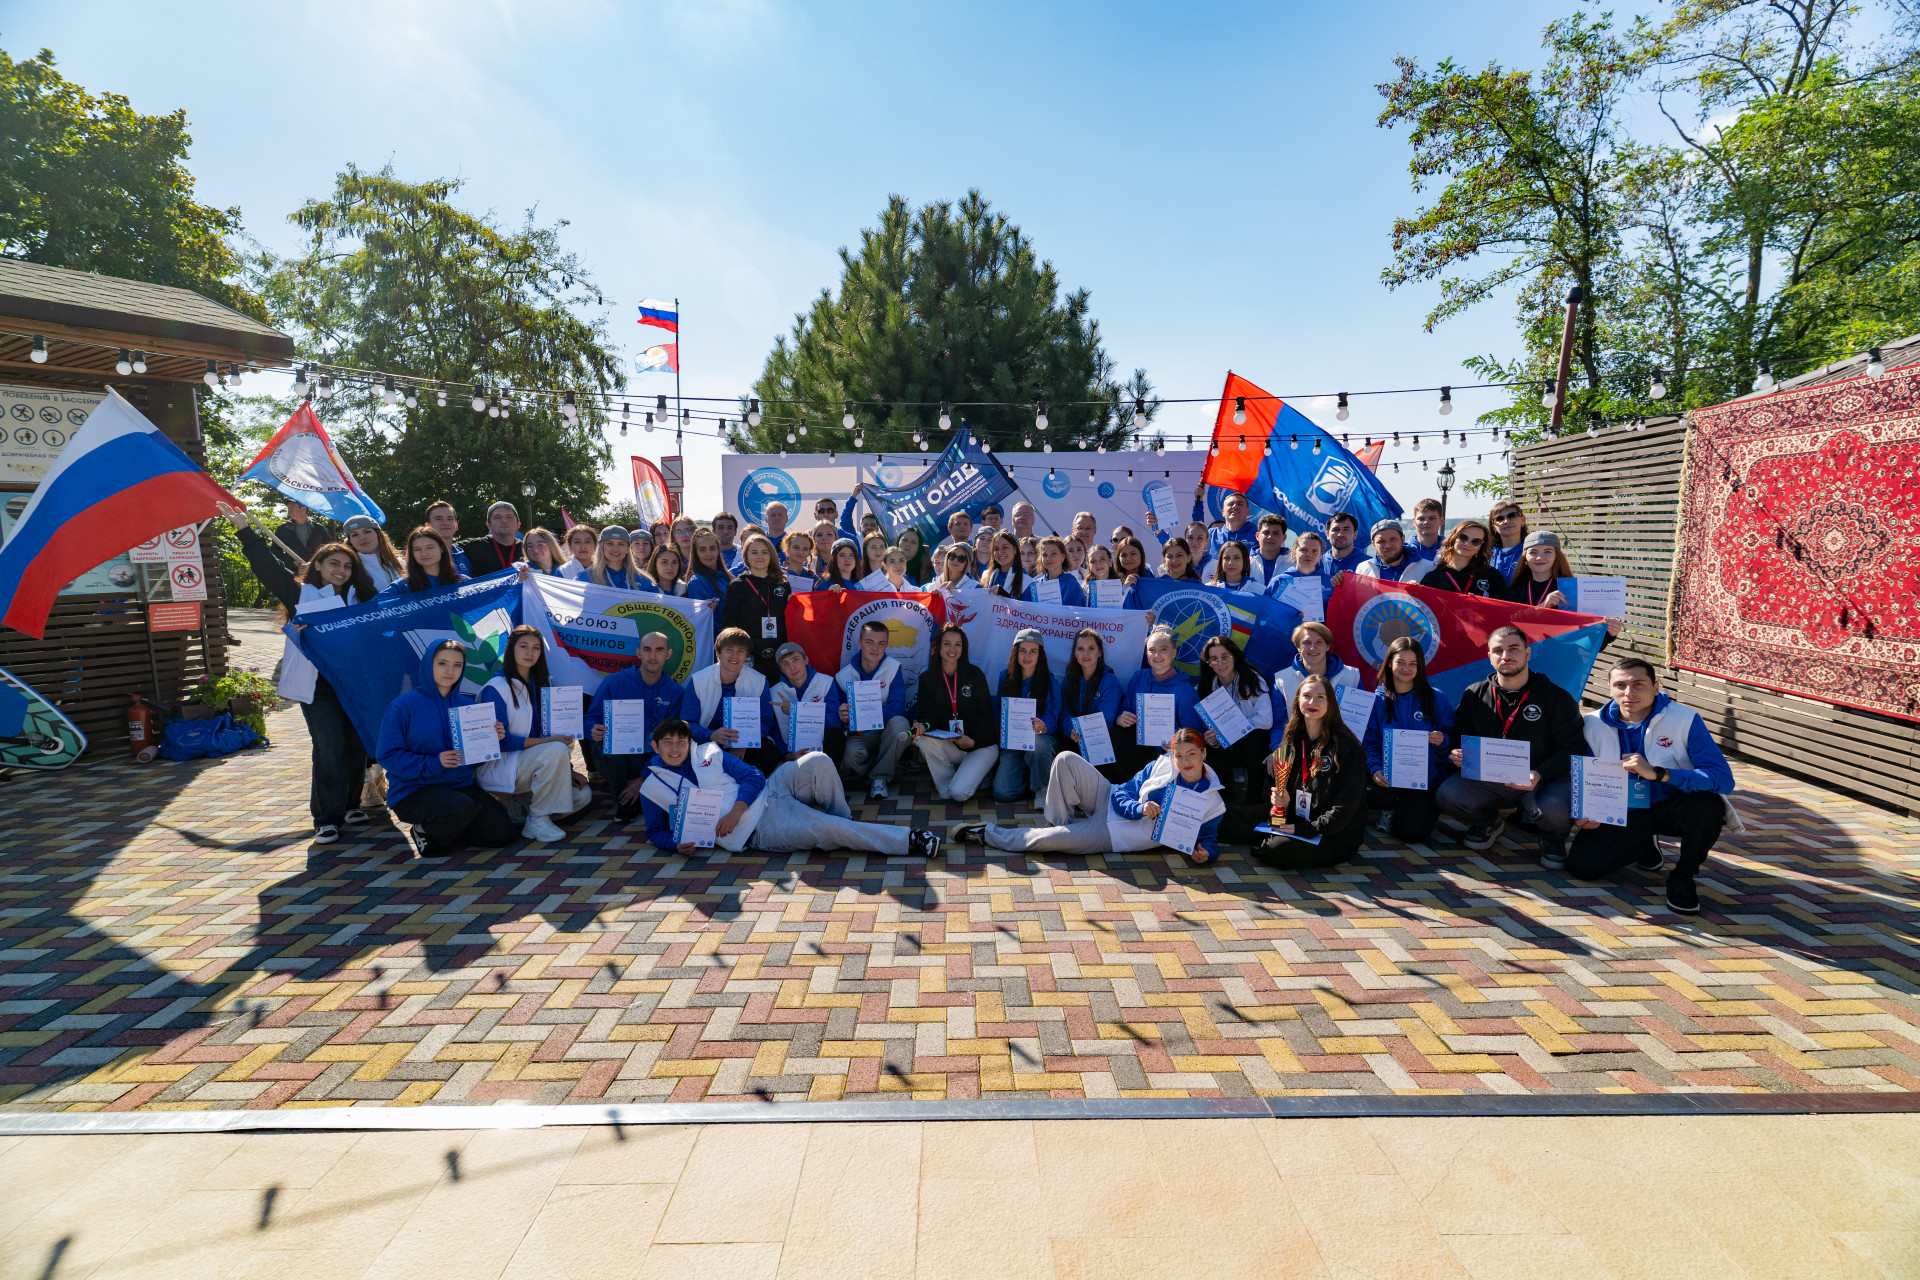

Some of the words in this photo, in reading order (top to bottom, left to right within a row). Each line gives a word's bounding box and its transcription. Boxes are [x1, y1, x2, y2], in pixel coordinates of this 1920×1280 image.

[2, 391, 51, 401] ПОВЕДЕНИЯ
[547, 611, 618, 630] РОФСОЮЗ
[617, 604, 694, 654] ОБЩЕСТВЕННОГО
[845, 600, 888, 651] ФЕДЕРАЦИЯ
[992, 604, 1049, 625] ПРОФСОЮЗ
[1051, 617, 1124, 633] РАБОТНИКОВ
[1154, 591, 1200, 611] РАБОТНИКОВ
[1202, 593, 1223, 610] СВЯЗИ
[1220, 612, 1229, 637] РОССИ
[1379, 594, 1438, 661] ЖИЗНЕОБЕСПЕЧЕНИ
[558, 632, 625, 650] БОТНИКОВ
[1572, 757, 1580, 818] сертификат
